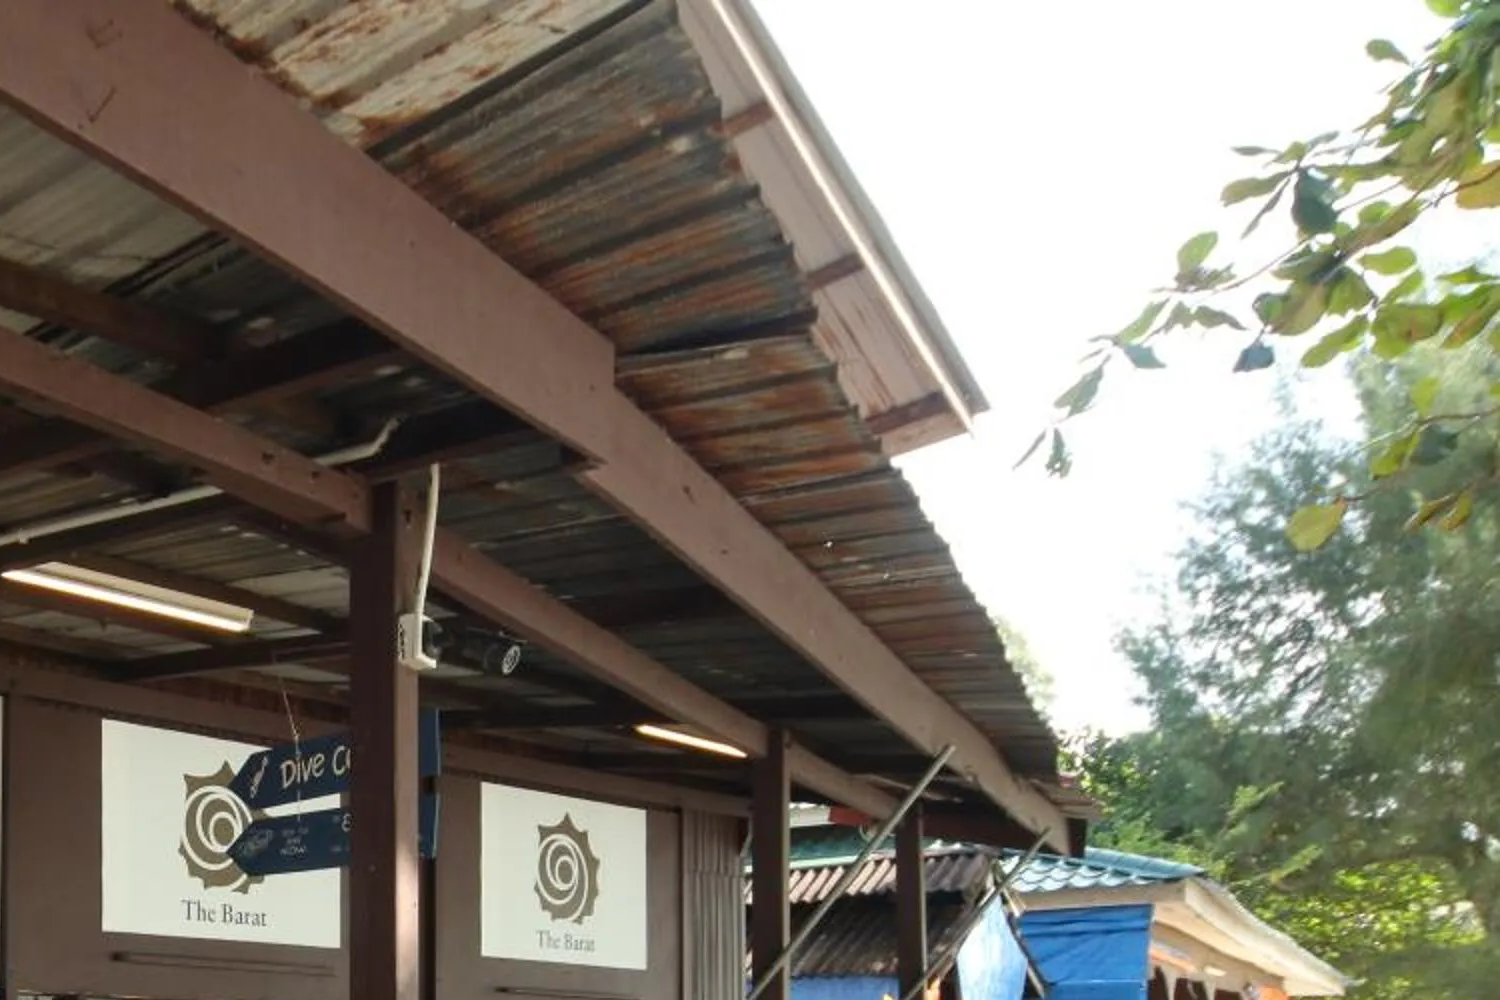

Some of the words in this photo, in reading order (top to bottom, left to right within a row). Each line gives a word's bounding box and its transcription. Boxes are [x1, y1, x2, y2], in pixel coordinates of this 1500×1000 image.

[280, 752, 325, 789] Dive
[181, 899, 216, 923] The
[221, 903, 267, 926] Barat
[536, 930, 561, 949] The
[563, 932, 595, 953] Barat
